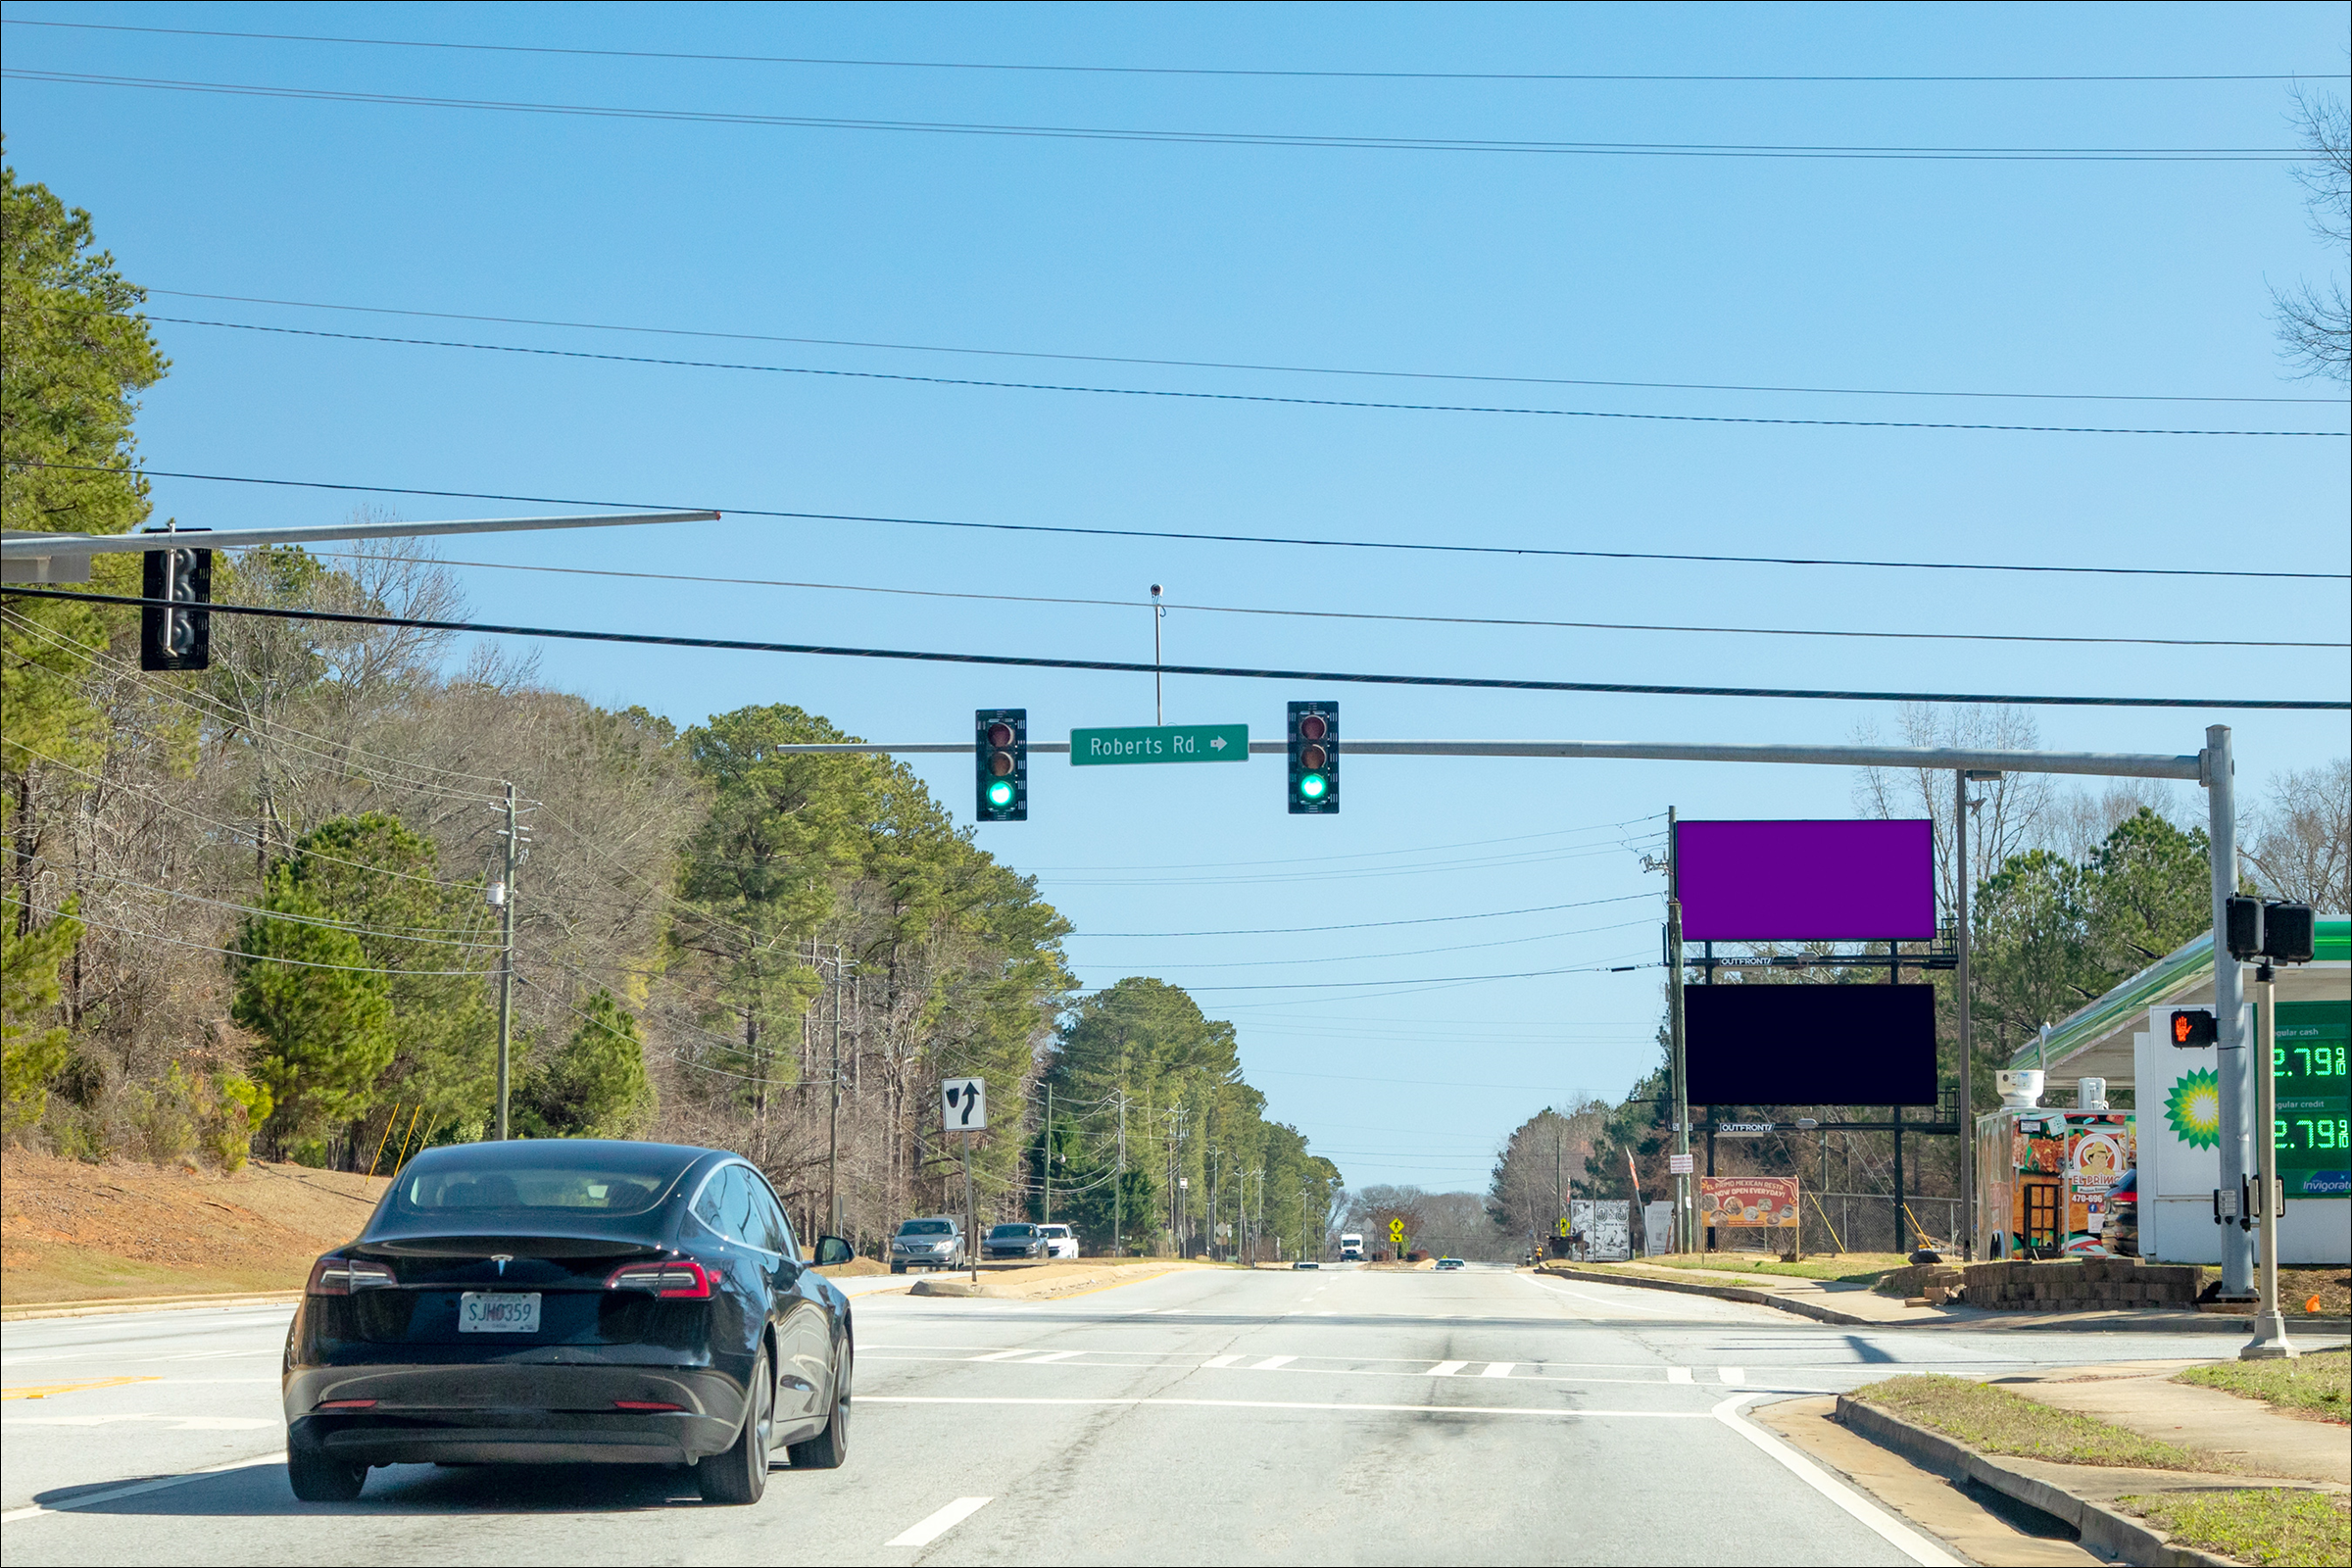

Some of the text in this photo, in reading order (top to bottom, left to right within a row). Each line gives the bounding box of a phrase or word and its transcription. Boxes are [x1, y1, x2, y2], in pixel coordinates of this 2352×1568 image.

[1091, 735, 1200, 756] Roberts Rd.
[2274, 1029, 2297, 1038] gular
[2073, 1175, 2083, 1184] EL
[1715, 1180, 1735, 1189] PRIMO
[1764, 1181, 1785, 1192] RESTR
[1749, 1187, 1786, 1198] EVERYDAY!
